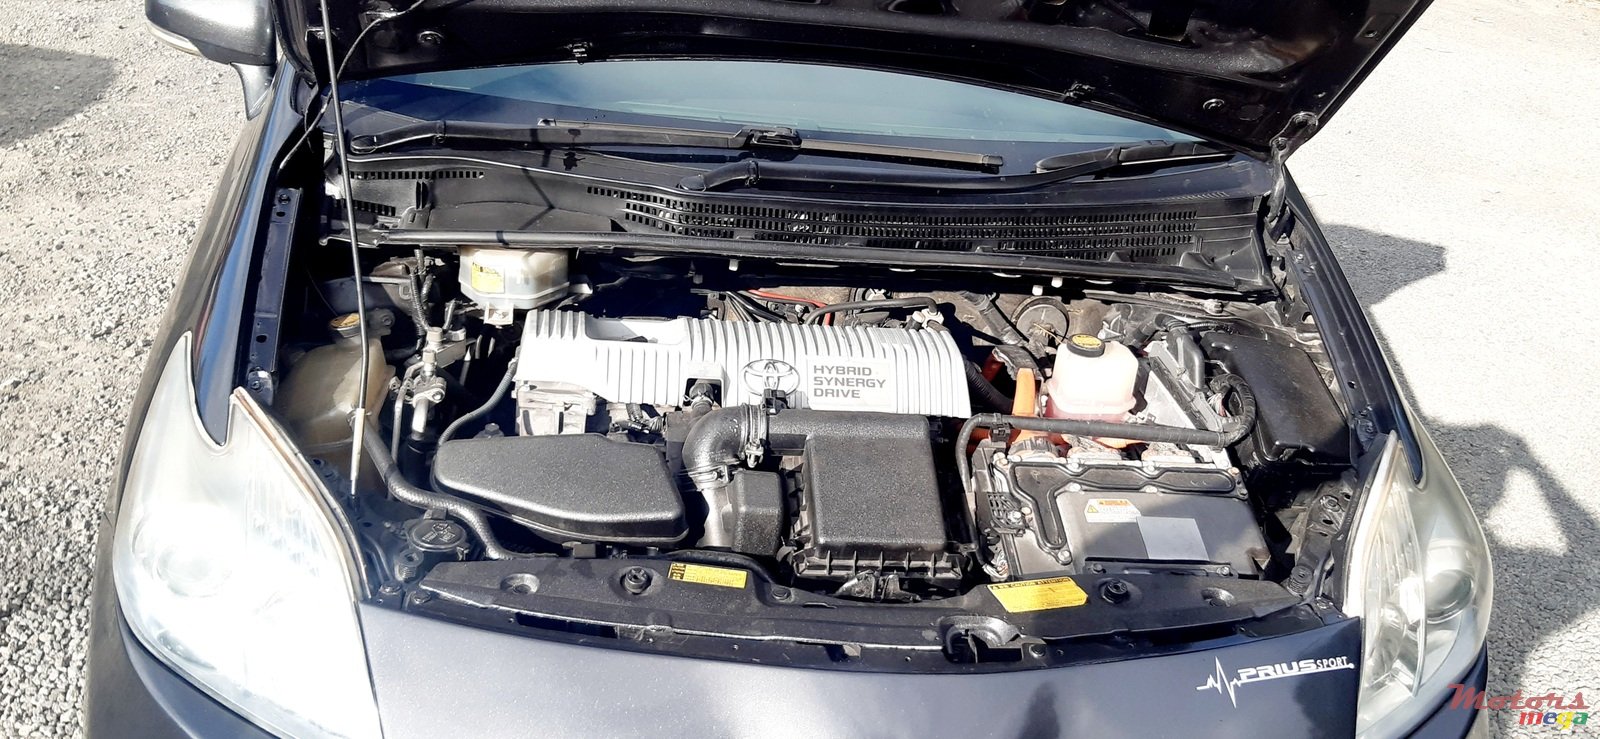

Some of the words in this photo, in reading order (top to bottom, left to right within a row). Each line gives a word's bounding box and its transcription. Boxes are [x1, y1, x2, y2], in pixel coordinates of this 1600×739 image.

[813, 365, 872, 376] HYBRID
[813, 376, 886, 388] SYNERGY
[813, 388, 861, 399] DRIVE
[1237, 659, 1317, 681] PRIUS
[1316, 656, 1348, 670] SPORT
